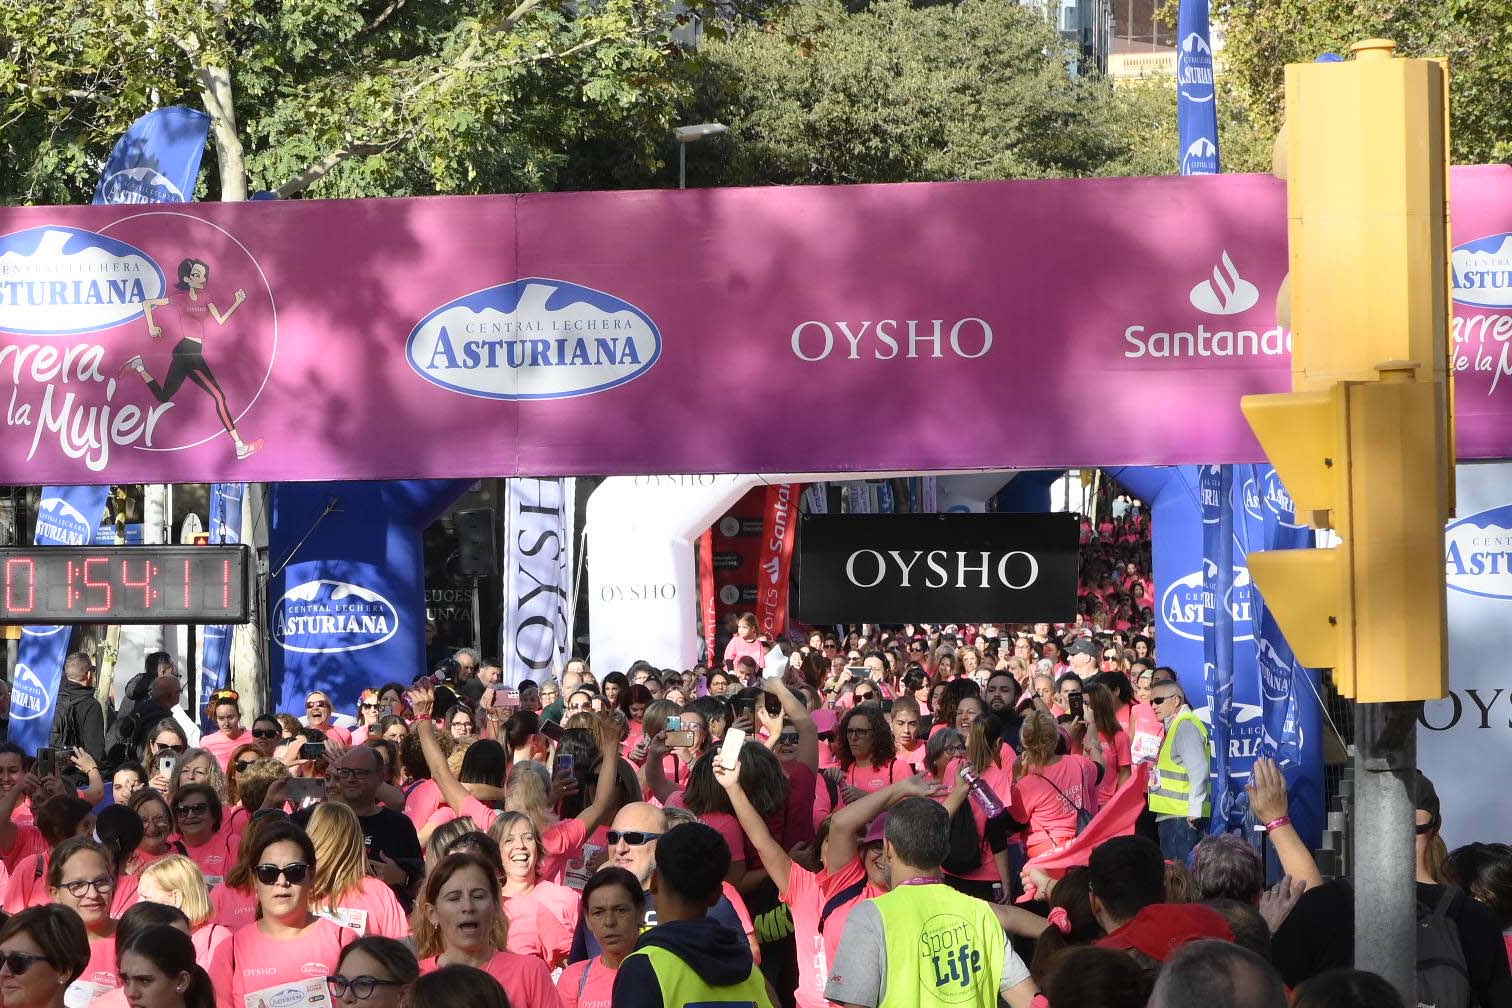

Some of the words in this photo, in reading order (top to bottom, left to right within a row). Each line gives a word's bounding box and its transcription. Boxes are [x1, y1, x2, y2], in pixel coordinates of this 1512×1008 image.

[465, 320, 545, 336] CENTRAL
[550, 317, 634, 333] LECHERA
[791, 317, 994, 361] OYSHO
[1124, 323, 1292, 359] Santand
[1452, 314, 1512, 343] arre
[426, 325, 642, 371] ASTURIANA
[1474, 344, 1493, 372] la
[6, 385, 33, 427] la
[26, 375, 176, 472] Mujer
[36, 521, 84, 545] STURIANA
[6, 557, 229, 612] 01:54:11
[515, 479, 567, 670] OYSH
[846, 548, 1040, 590] OYSHO
[289, 604, 330, 613] CENTRAL
[335, 603, 384, 613] LECHERA
[600, 582, 677, 602] OYSHO
[276, 609, 389, 636] ASTURIANA
[1417, 688, 1512, 731] OY
[921, 922, 972, 958] Sport
[931, 943, 980, 987] Life
